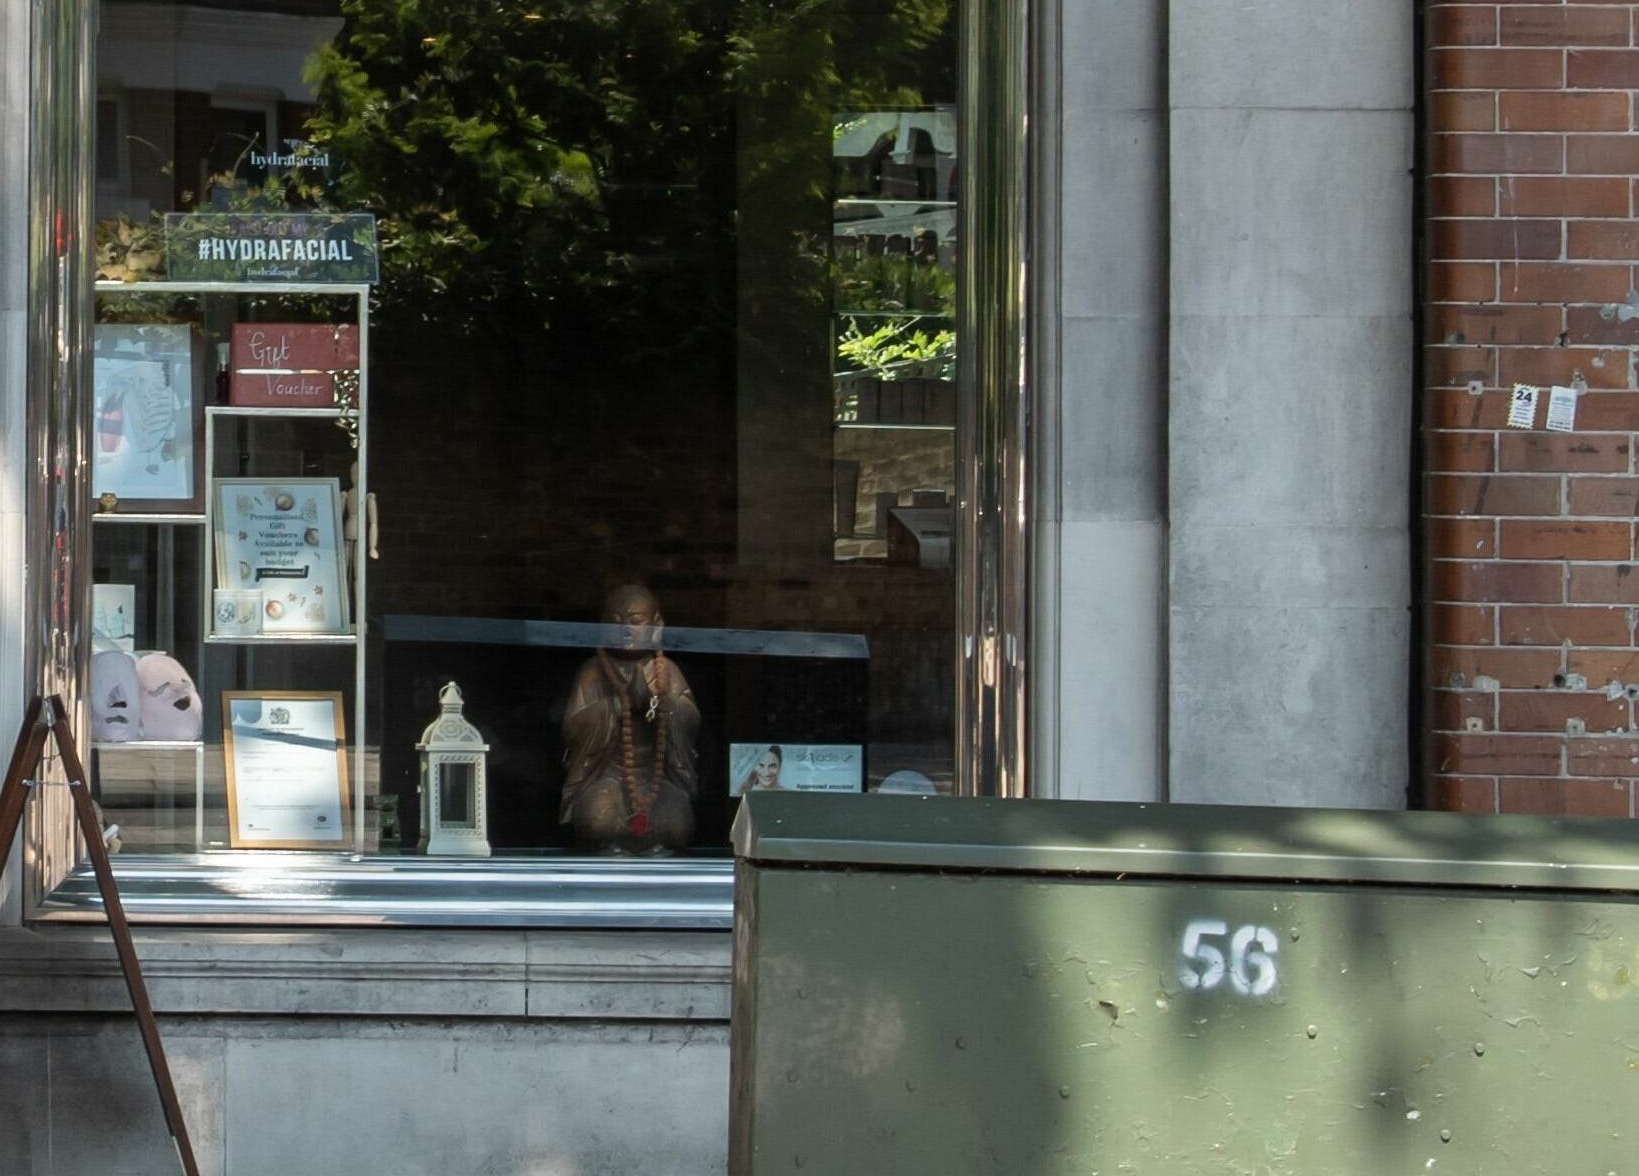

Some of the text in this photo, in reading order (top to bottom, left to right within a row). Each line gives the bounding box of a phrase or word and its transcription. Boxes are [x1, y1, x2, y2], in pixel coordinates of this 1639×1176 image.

[250, 151, 329, 170] hydrafacial
[198, 238, 353, 261] #HYDRAFACIAL
[249, 331, 290, 369] Gift
[266, 374, 323, 396] Voucher
[1516, 390, 1532, 402] 24
[1179, 920, 1278, 995] 56
